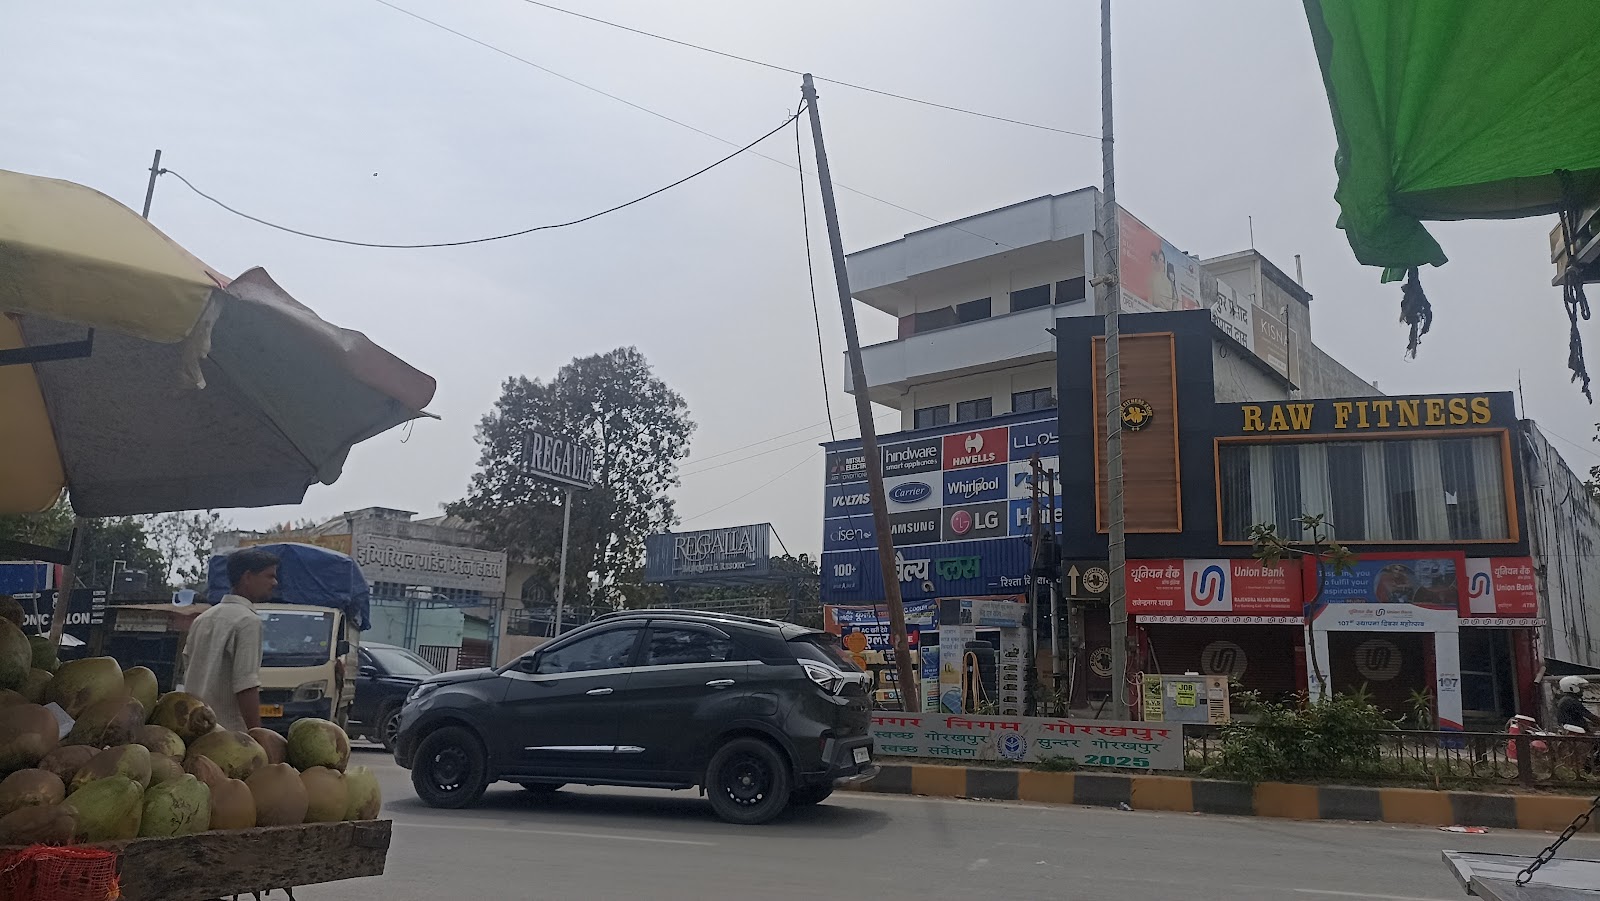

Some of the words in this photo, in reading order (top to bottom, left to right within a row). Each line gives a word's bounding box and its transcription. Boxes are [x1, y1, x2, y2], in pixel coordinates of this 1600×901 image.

[1260, 319, 1288, 346] KISNA
[1241, 403, 1315, 431] RAW
[1332, 396, 1492, 430] FITNESS
[531, 432, 595, 484] REGALIA
[885, 446, 938, 463] hindware
[952, 452, 996, 466] HAVELLS
[885, 463, 904, 471] smart
[894, 486, 926, 499] Carrier
[947, 477, 999, 499] Whirlpool
[832, 493, 871, 508] VOLTAS
[974, 510, 999, 530] LG
[890, 520, 936, 535] AMSUNG
[673, 530, 755, 562] REGALIA
[720, 562, 746, 571] RESORT
[833, 563, 857, 577] 100+
[935, 555, 983, 581] प्लस
[1131, 565, 1163, 583] यूनियन
[1165, 564, 1180, 579] बैंक
[1234, 566, 1259, 577] Union
[1261, 566, 1284, 577] Bank
[1494, 565, 1518, 579] यूनियन
[1000, 575, 1022, 588] रिश्ता
[1331, 578, 1349, 586] fulfil
[1496, 584, 1515, 592] Union
[1516, 583, 1534, 591] Bank
[1324, 588, 1368, 596] aspirations
[909, 604, 928, 613] COOLER
[1381, 619, 1398, 627] दिवस
[1309, 675, 1328, 683] 17
[1438, 677, 1458, 687] 107
[945, 715, 1021, 732] निगम
[1043, 720, 1173, 741] गोरखपुर
[873, 730, 915, 740] स्वच्छ
[924, 730, 989, 746] गोरखपुर
[881, 744, 919, 753] स्वच्छ
[928, 744, 976, 757] सर्वेक्षण
[1036, 737, 1080, 749] सुन्दर
[1091, 739, 1163, 754] गोरखपुर
[1084, 754, 1150, 768] 2025
